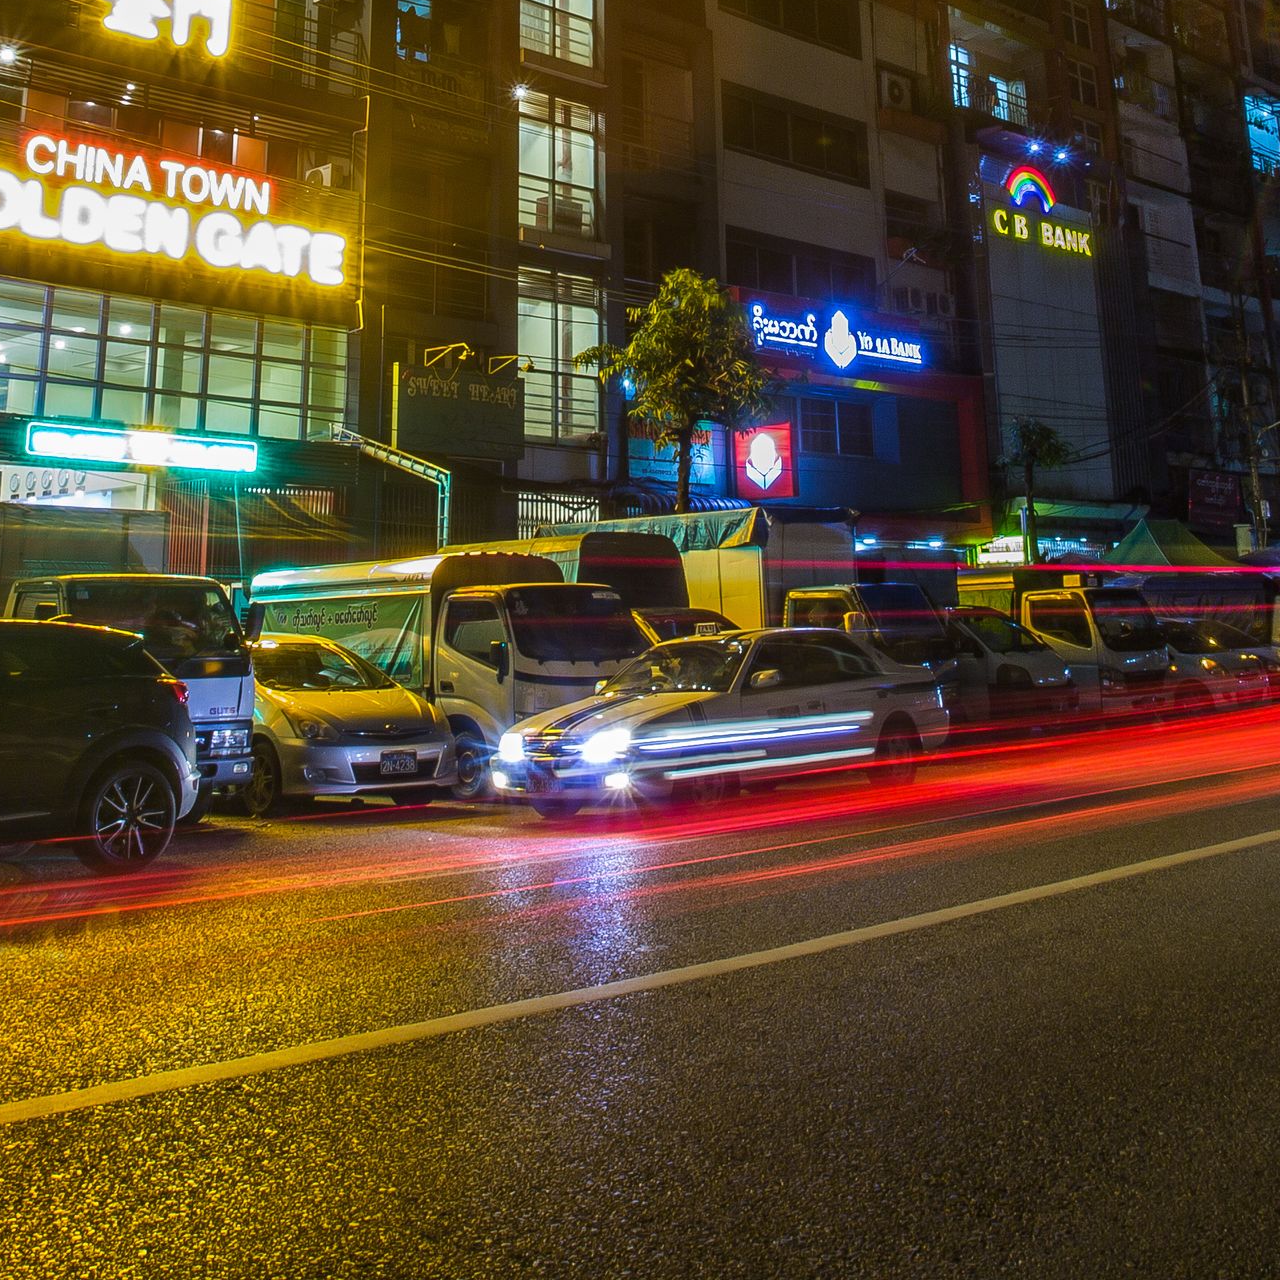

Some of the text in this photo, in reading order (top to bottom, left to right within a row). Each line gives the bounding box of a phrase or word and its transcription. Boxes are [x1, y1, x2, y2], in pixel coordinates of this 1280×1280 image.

[26, 136, 271, 215] CHINA TOWN
[196, 211, 347, 287] GATE
[1041, 223, 1092, 257] BANK
[889, 338, 922, 360] BANK
[407, 374, 518, 408] SWEET HEART
[209, 706, 237, 715] GUTS
